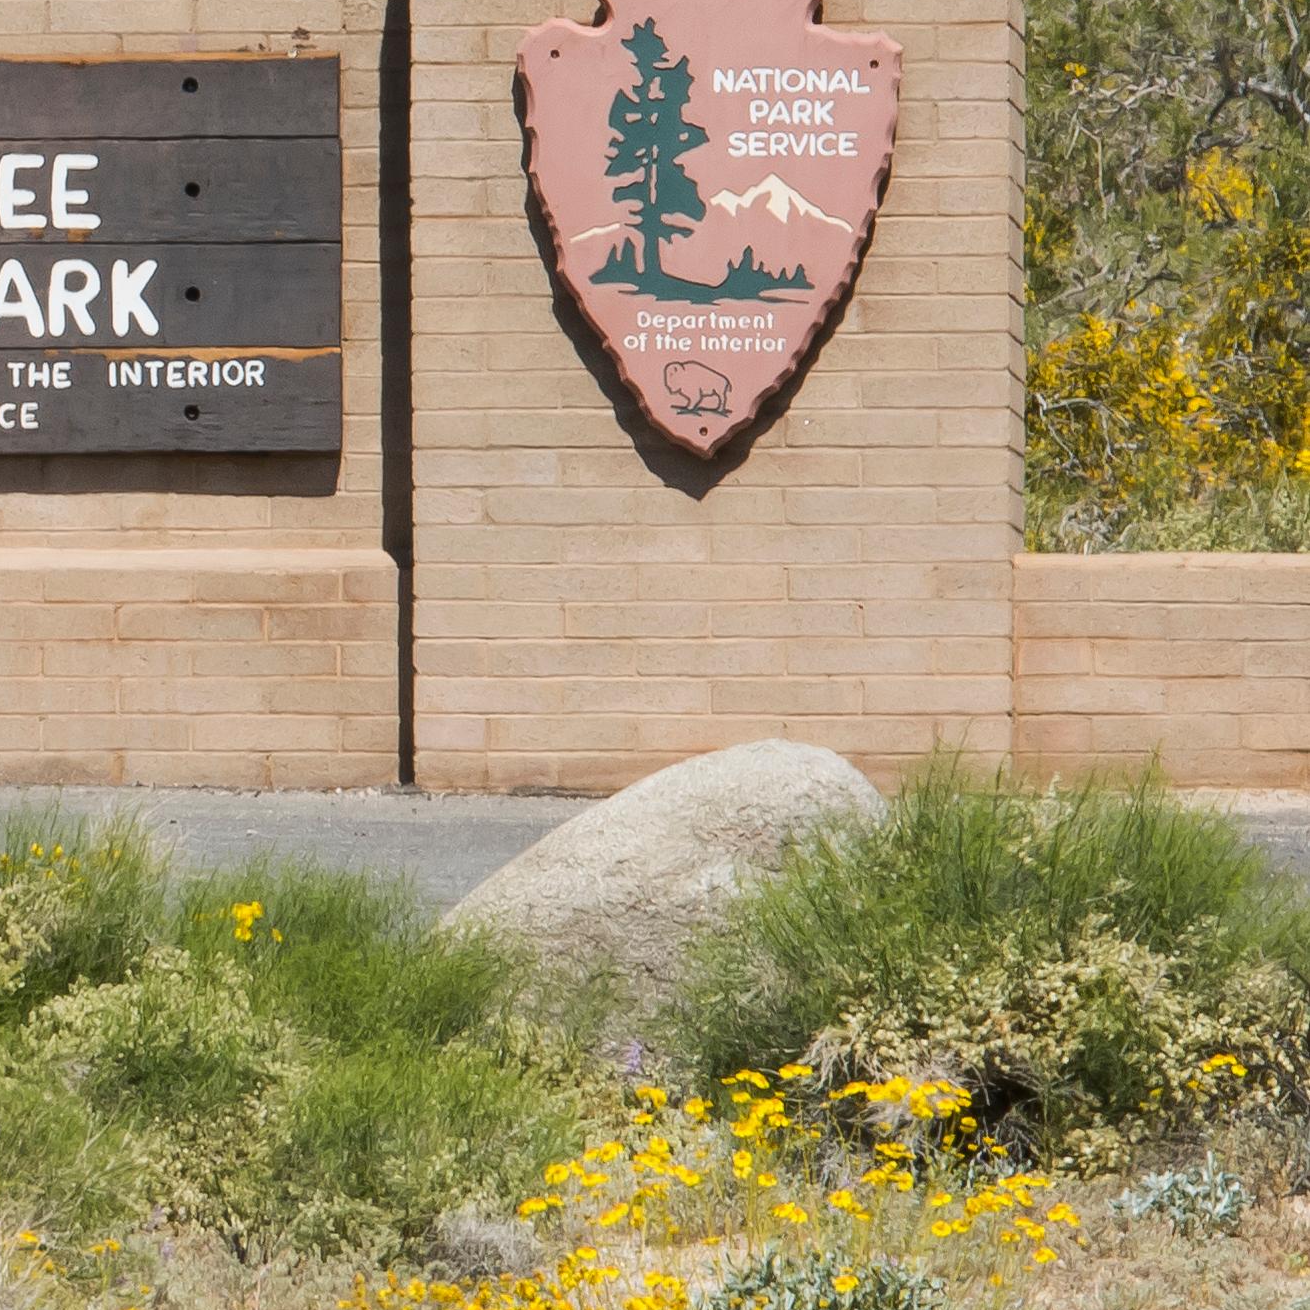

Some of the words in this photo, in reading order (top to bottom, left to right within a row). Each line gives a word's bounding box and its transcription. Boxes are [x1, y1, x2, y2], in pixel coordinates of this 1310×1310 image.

[712, 67, 871, 95] NATIONAL
[749, 98, 835, 126] PARK
[727, 131, 859, 158] SERVICE
[636, 310, 774, 333] Department
[623, 332, 648, 353] of
[654, 330, 693, 352] the
[700, 332, 787, 353] Interior
[7, 361, 72, 389] THE
[108, 359, 265, 389] INTERIOR
